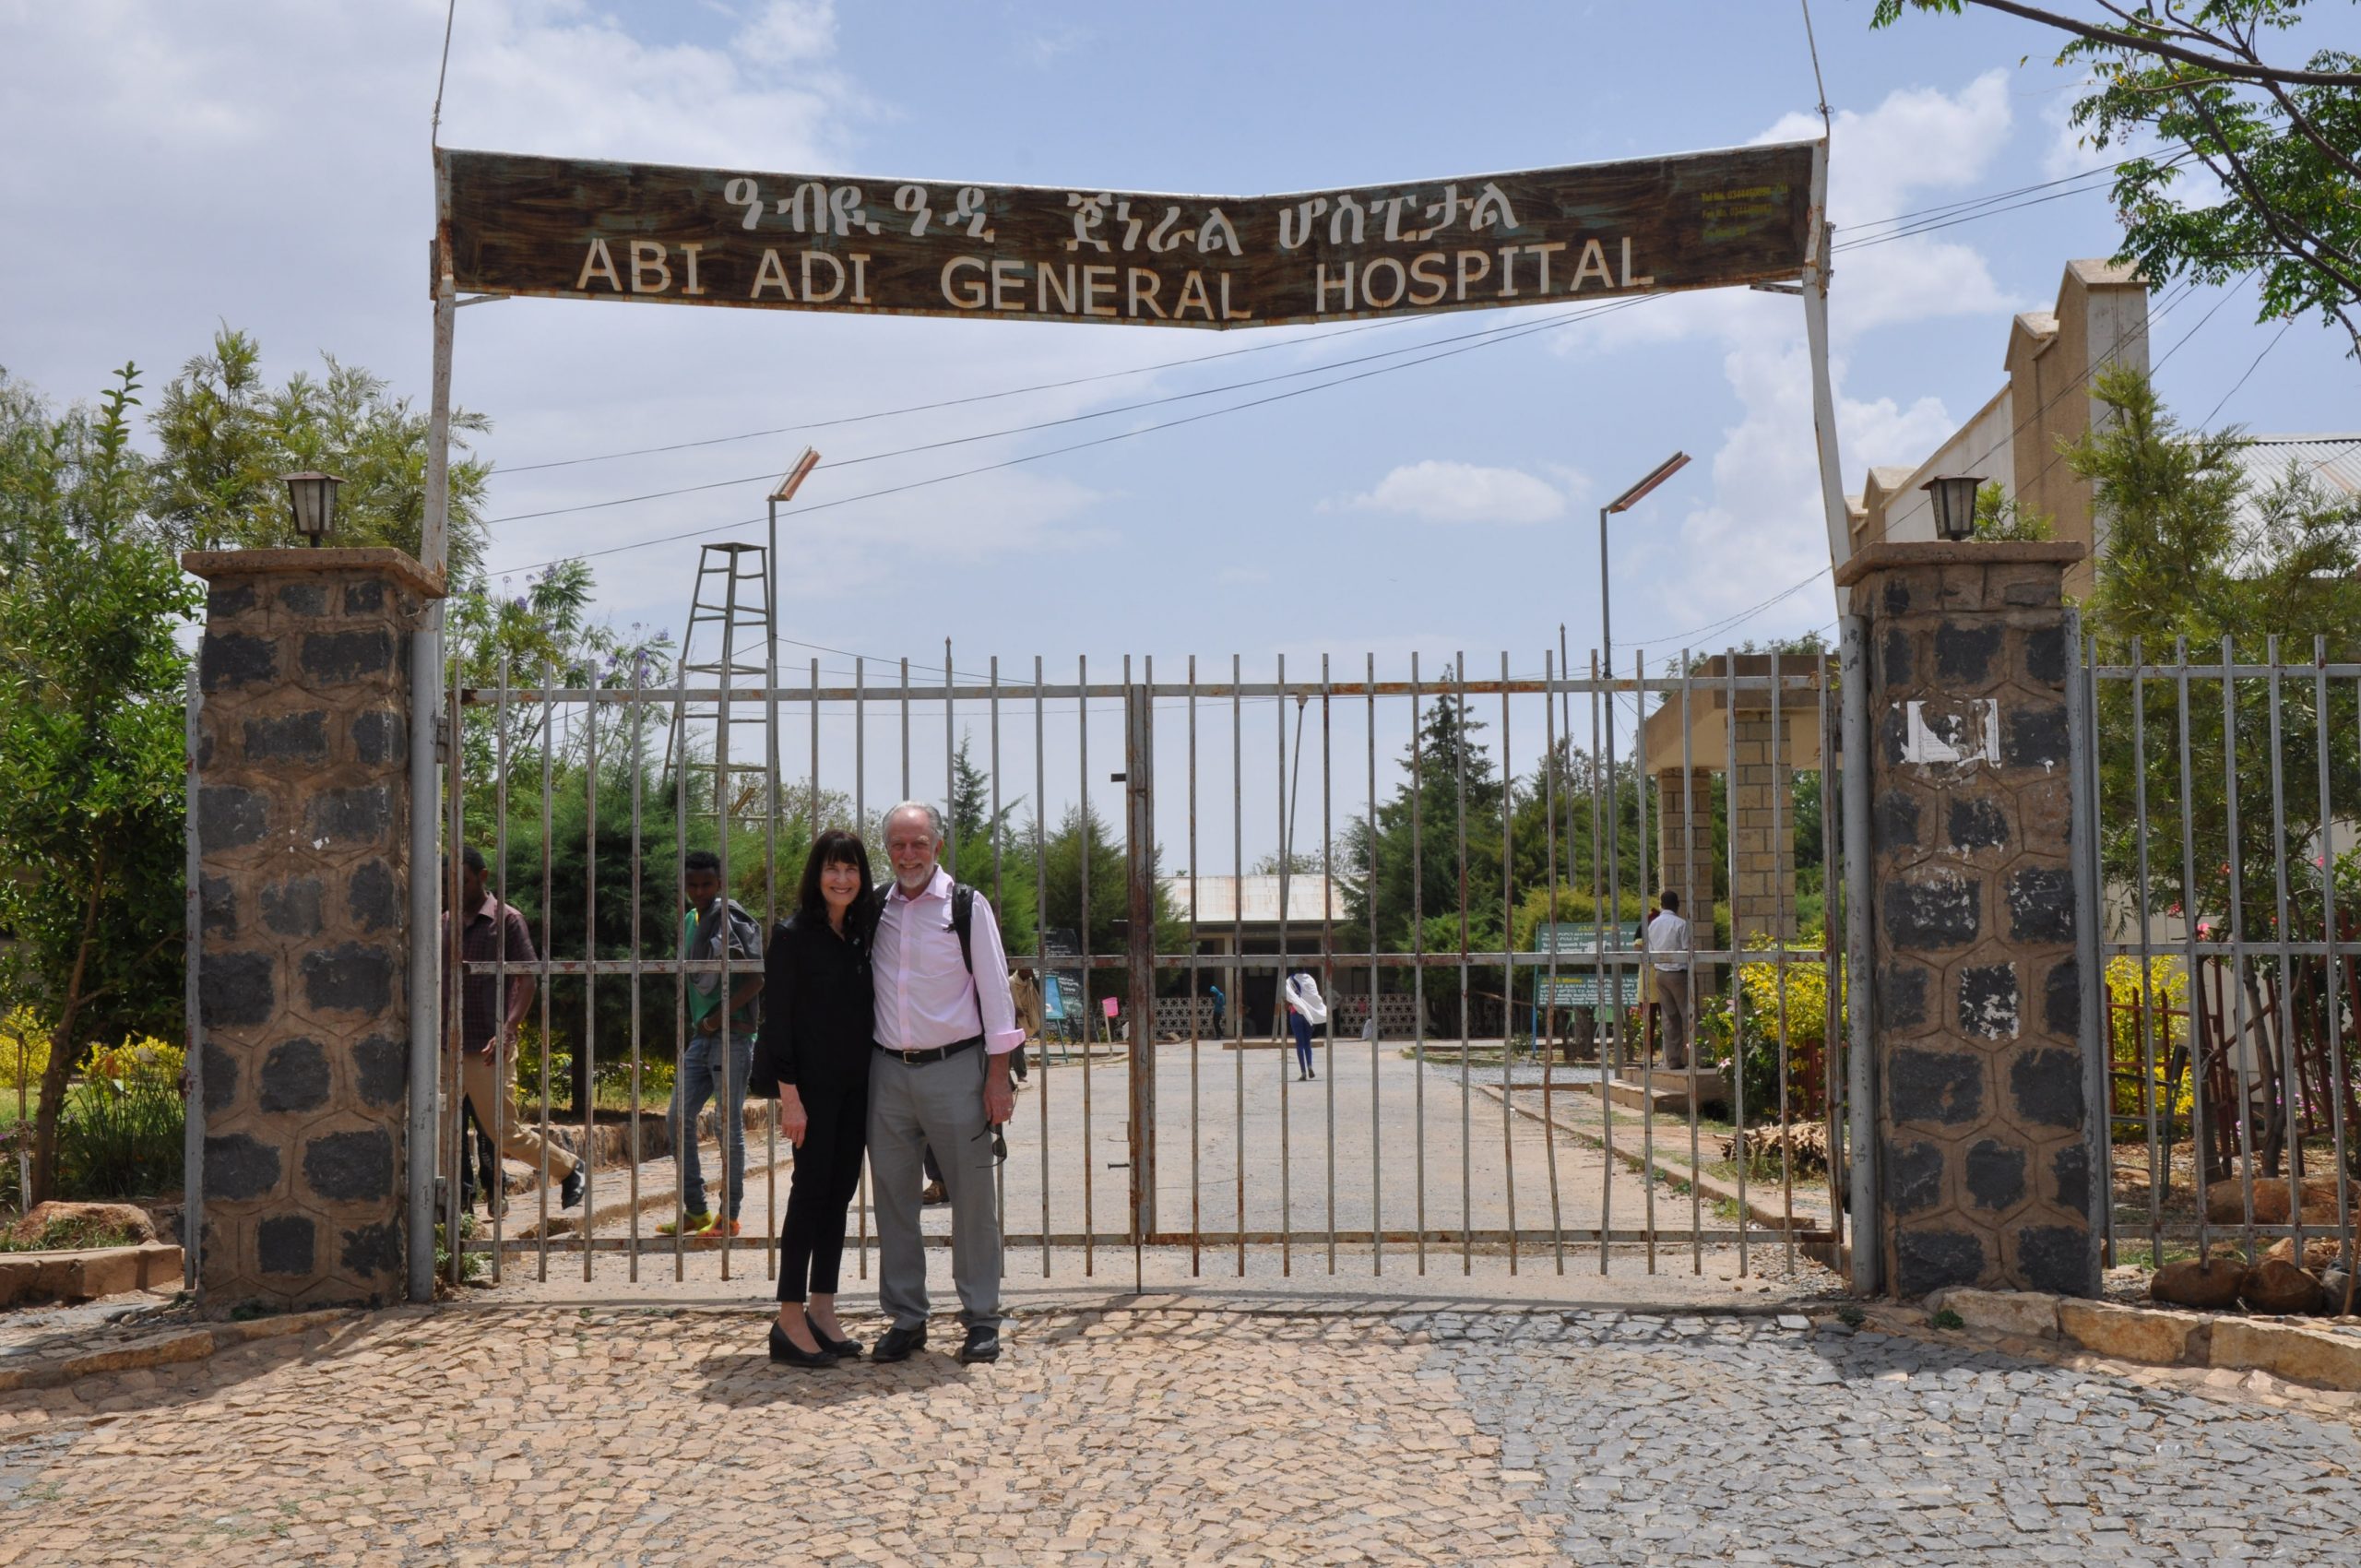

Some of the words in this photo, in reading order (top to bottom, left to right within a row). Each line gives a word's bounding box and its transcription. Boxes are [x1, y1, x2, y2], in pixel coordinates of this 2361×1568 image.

[575, 237, 706, 296] ABI
[750, 247, 872, 305] ADI
[940, 255, 1252, 321] GENERAL
[1315, 236, 1655, 313] HOSPITAL
